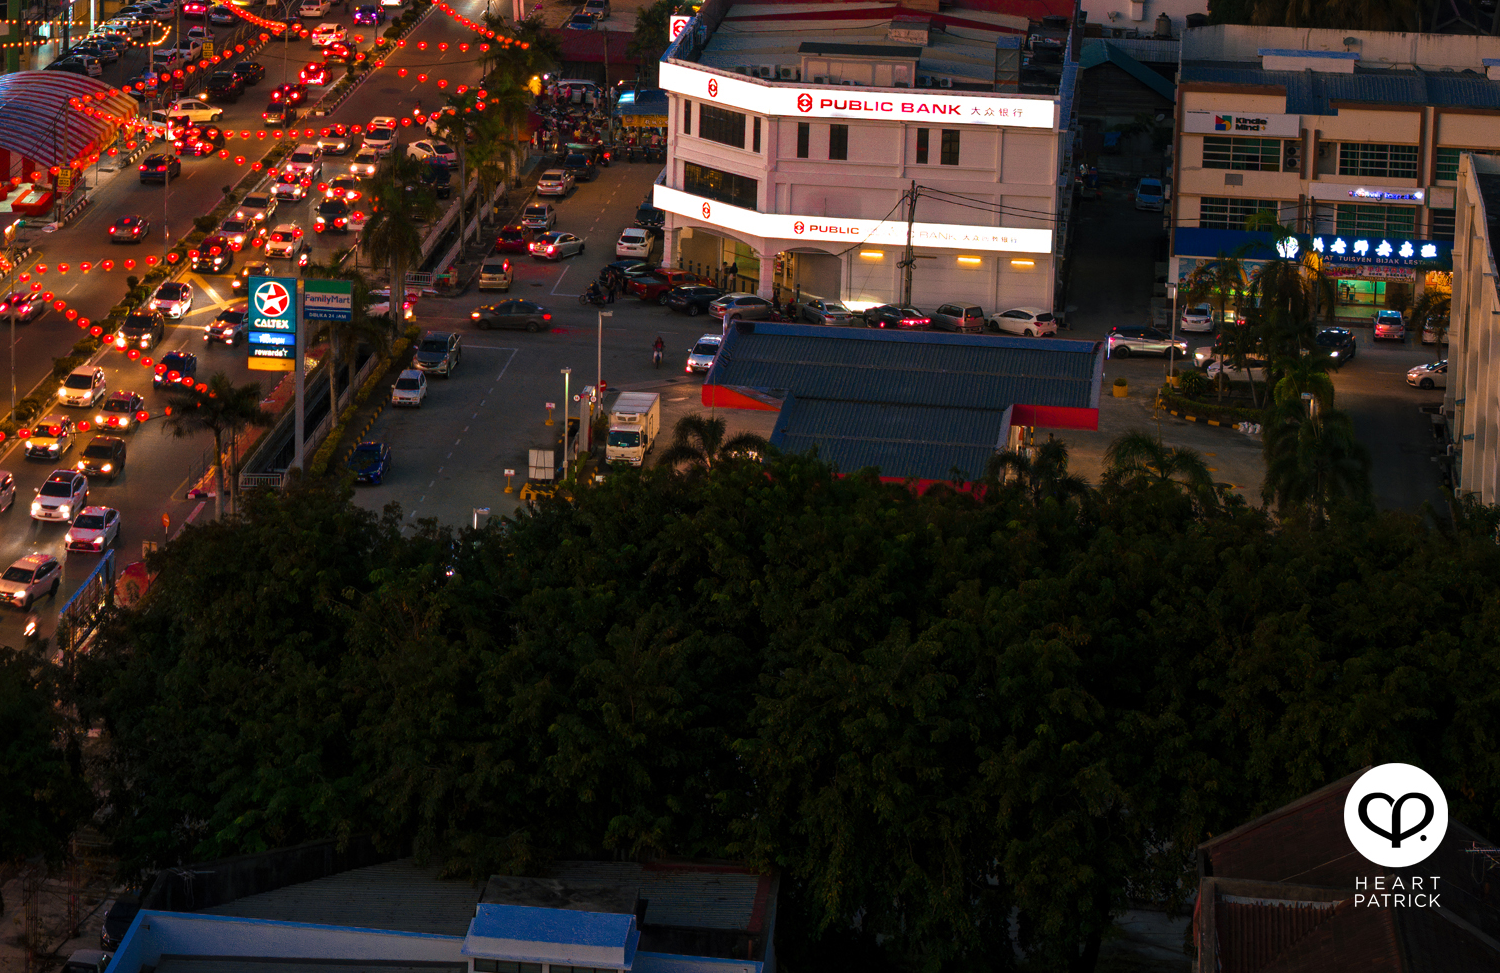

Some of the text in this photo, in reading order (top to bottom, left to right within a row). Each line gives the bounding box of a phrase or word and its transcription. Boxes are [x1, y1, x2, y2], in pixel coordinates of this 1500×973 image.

[820, 98, 962, 116] PUBLIC BANK
[970, 106, 1024, 118] 大众银行
[1235, 117, 1267, 125] Kindle
[809, 225, 860, 235] PUBLIC
[1338, 255, 1372, 263] TUISYEN
[1376, 257, 1400, 265] BIJAK
[305, 294, 351, 305] FamilyMart
[254, 318, 290, 329] CALTEX
